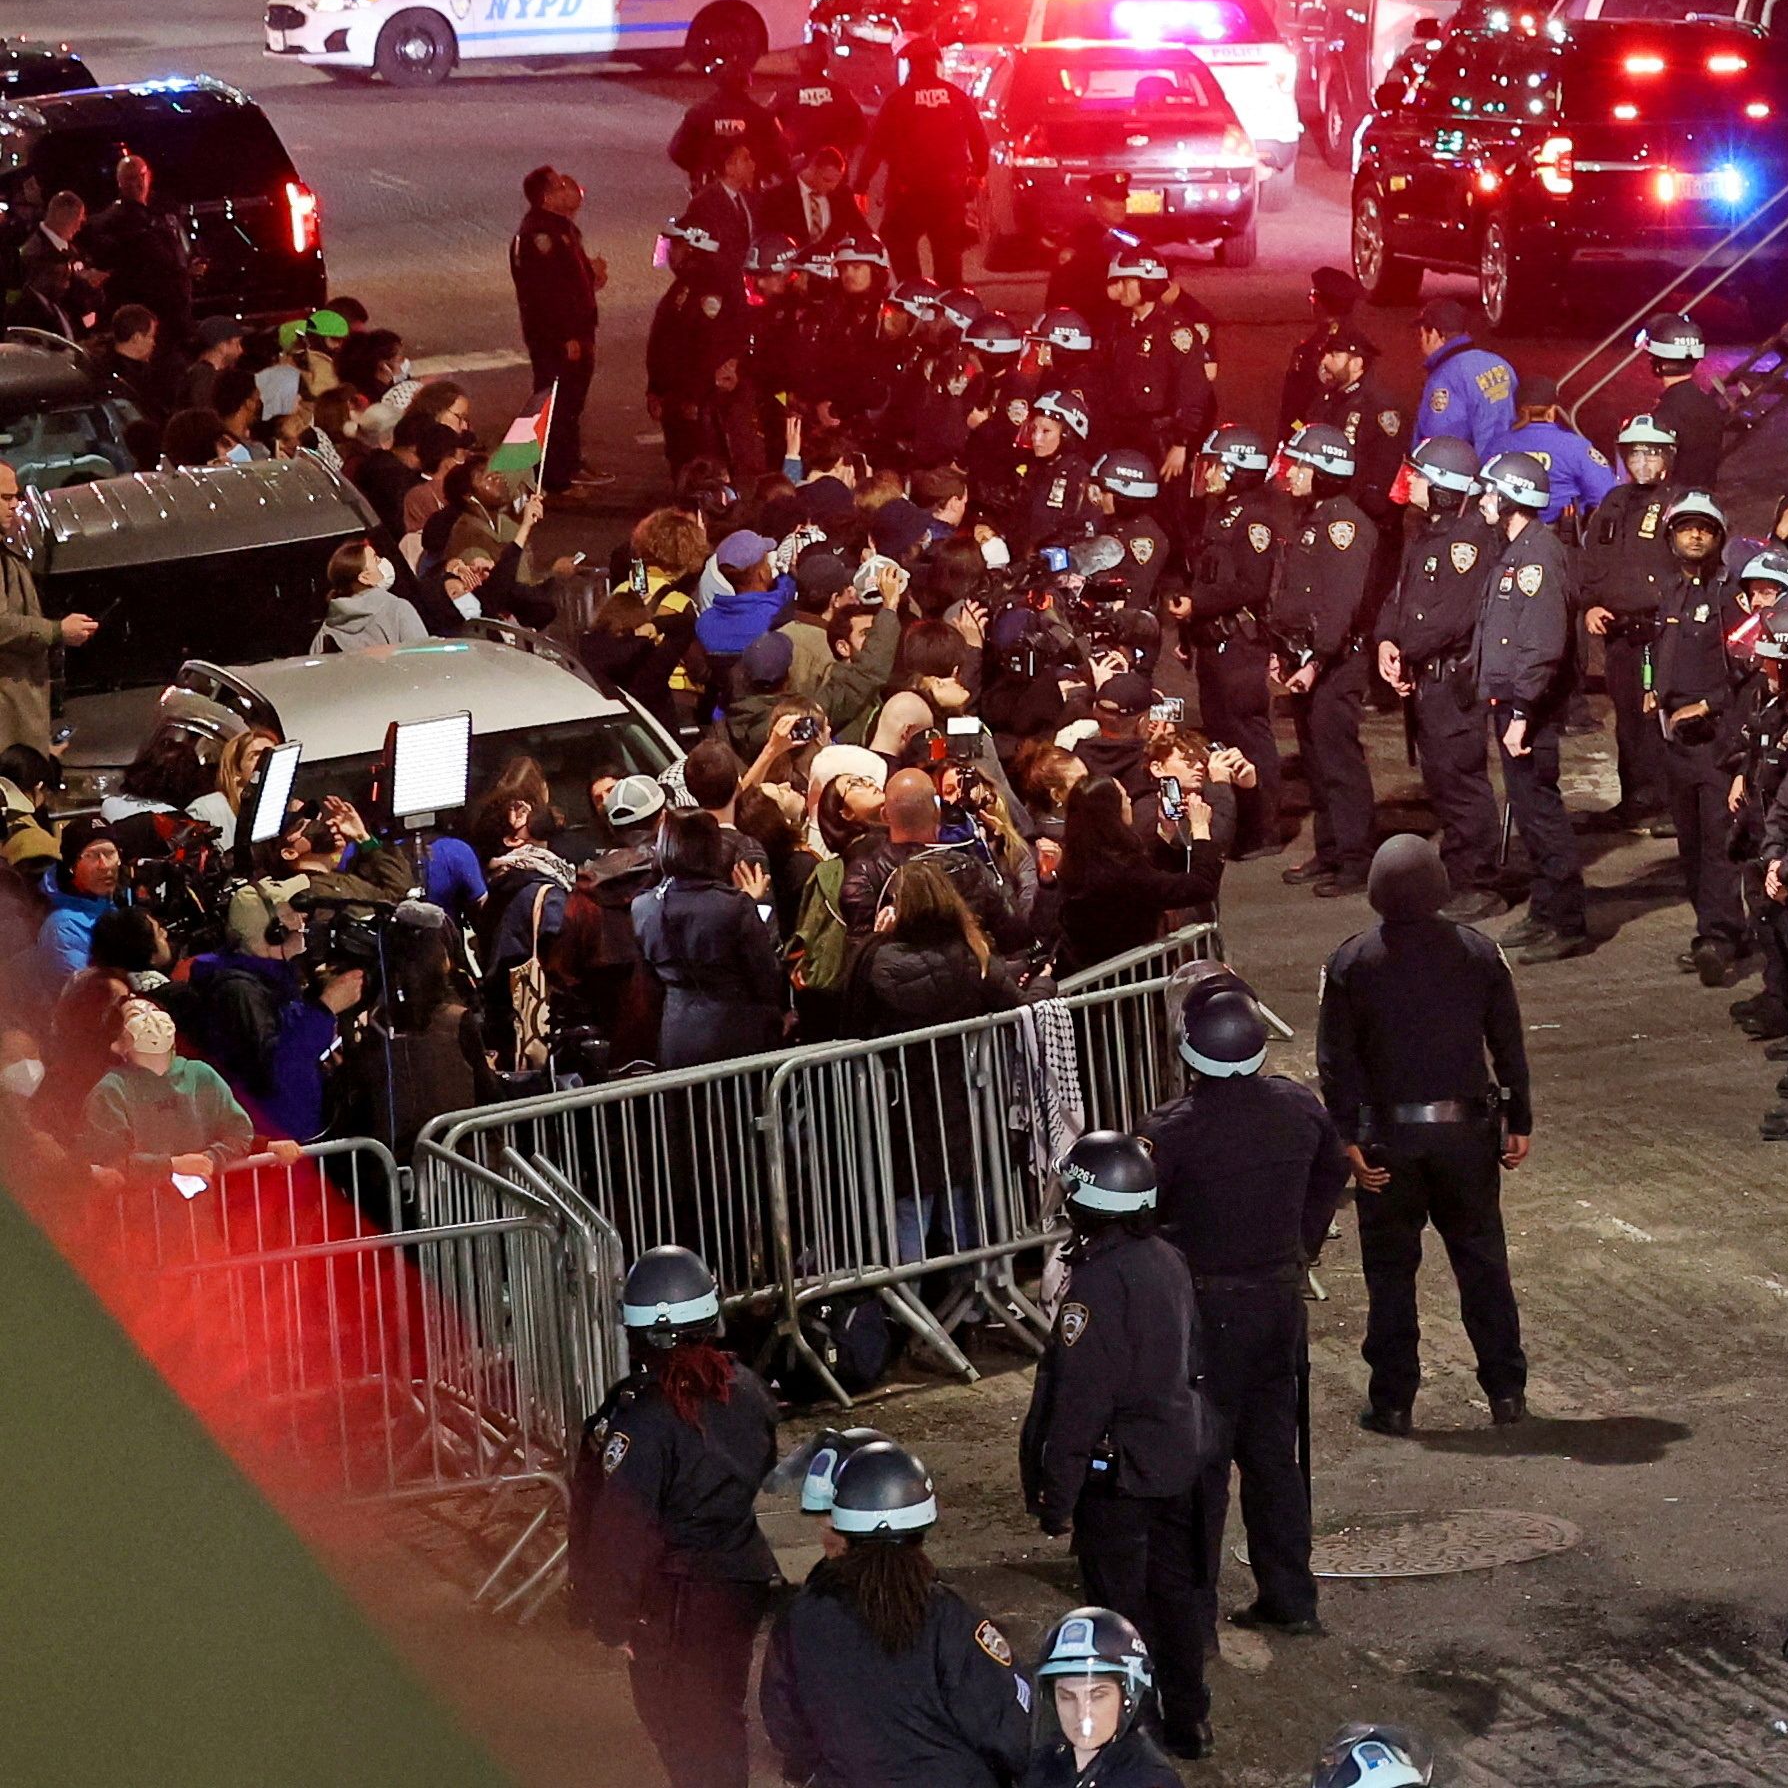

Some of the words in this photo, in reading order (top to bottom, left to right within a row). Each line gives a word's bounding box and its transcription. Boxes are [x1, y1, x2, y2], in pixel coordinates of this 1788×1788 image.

[799, 87, 831, 102] NYPD
[914, 88, 948, 103] NYPD
[714, 118, 745, 132] NYPD
